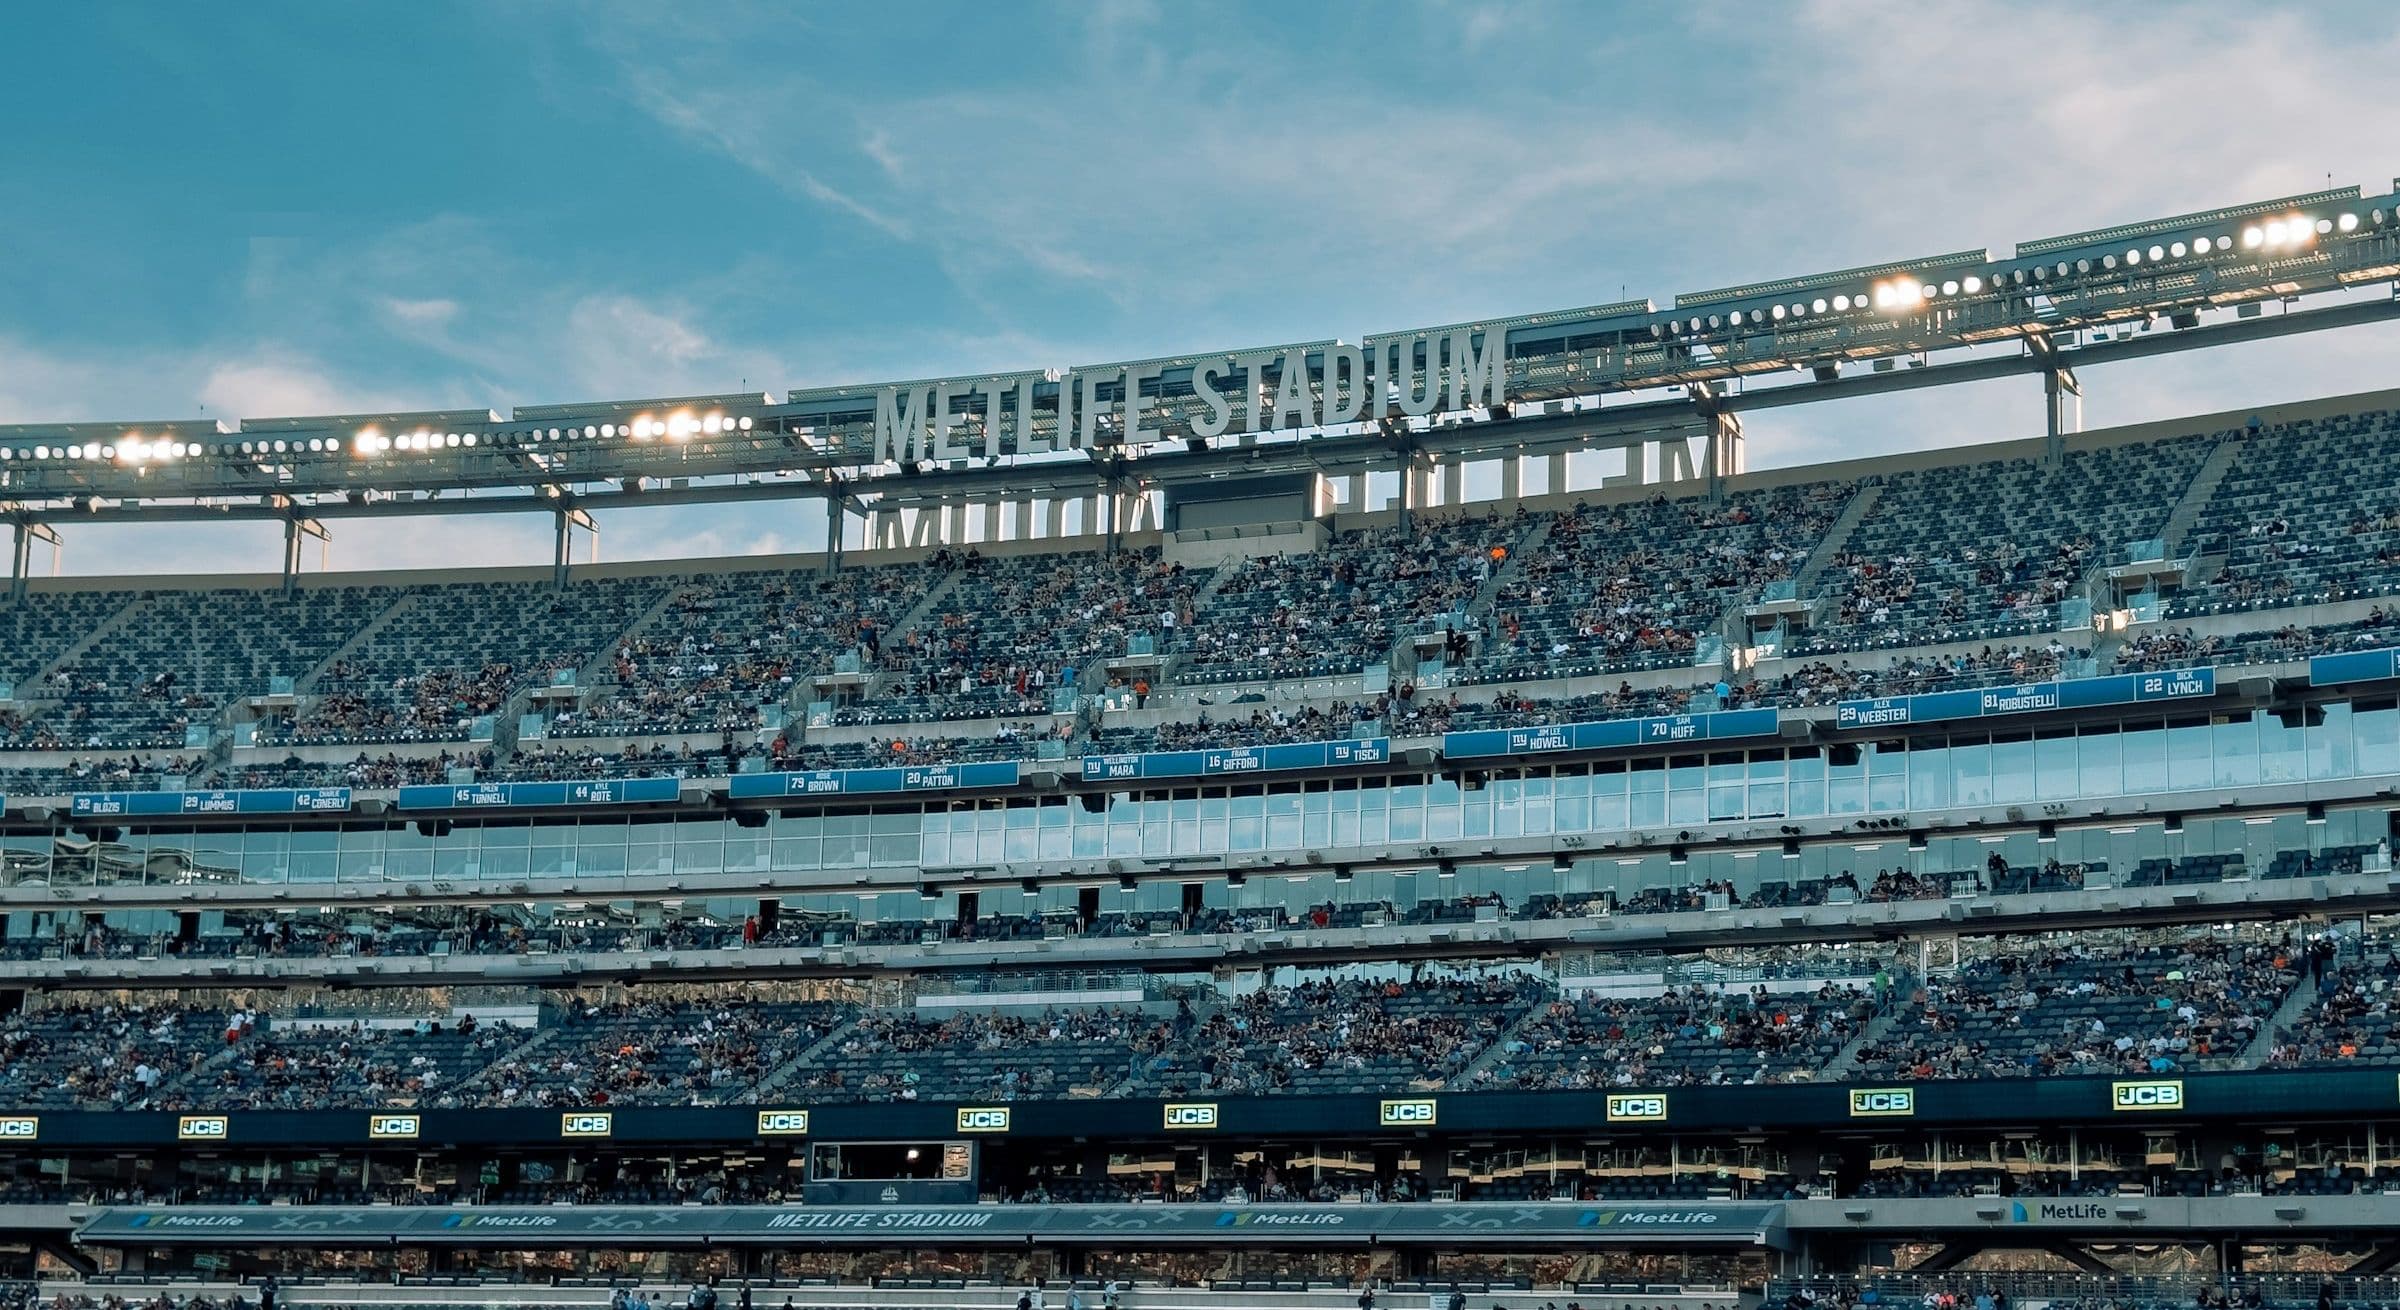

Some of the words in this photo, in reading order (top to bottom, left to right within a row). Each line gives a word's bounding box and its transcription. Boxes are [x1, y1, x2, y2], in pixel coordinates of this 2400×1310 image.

[874, 366, 1162, 464] METLIFE
[1190, 325, 1506, 437] STADIUM
[2176, 671, 2193, 680] DICK
[2016, 686, 2036, 696] ANDY
[2144, 678, 2162, 692] 22
[2167, 680, 2203, 696] LYNCH
[1873, 700, 1890, 709] ALEX
[1984, 694, 1998, 708] 81
[1999, 694, 2055, 711] ROBUSTELLI
[1840, 707, 1856, 721] 29
[1857, 708, 1907, 724] WEBSTER
[1676, 716, 1691, 725] SAM
[1537, 728, 1549, 737] JIM
[1550, 727, 1561, 736] LEE
[1652, 723, 1667, 736] 70
[1671, 725, 1696, 739] HUFF
[1530, 735, 1568, 750] HOWELL
[1231, 749, 1251, 758] FRANK
[1353, 749, 1379, 761] TISCH
[1209, 756, 1221, 767] 16
[1223, 757, 1258, 770] GIFFORD
[1109, 765, 1135, 776] MARA
[791, 777, 804, 789] 79
[907, 772, 920, 784] 20
[922, 775, 953, 787] PATTON
[575, 786, 587, 798] 44
[808, 780, 839, 792] BROWN
[185, 796, 198, 807] 29
[297, 794, 310, 805] 42
[456, 790, 470, 801] 45
[472, 793, 506, 804] TUNNELL
[591, 791, 612, 801] ROTE
[77, 798, 90, 810] 32
[200, 799, 234, 811] LUMMUS
[312, 797, 346, 809] CONERLY
[1855, 1093, 1909, 1110] JCB
[2118, 1086, 2178, 1105] JCB
[1385, 1104, 1432, 1120] JCB
[1611, 1099, 1663, 1116] JCB
[961, 1112, 1006, 1127] JCB
[1168, 1108, 1214, 1124] JCB
[182, 1120, 224, 1135] JCB
[373, 1119, 416, 1134] JCB
[565, 1117, 608, 1132] JCB
[762, 1115, 804, 1130] JCB
[2041, 1204, 2107, 1218] MetLife
[163, 1215, 244, 1227] MetLife
[475, 1215, 557, 1227] MetLife
[766, 1213, 877, 1228] METLIFE
[876, 1213, 993, 1228] STADIUM
[1252, 1213, 1344, 1225] MetLife
[1619, 1212, 1718, 1224] MetLife
